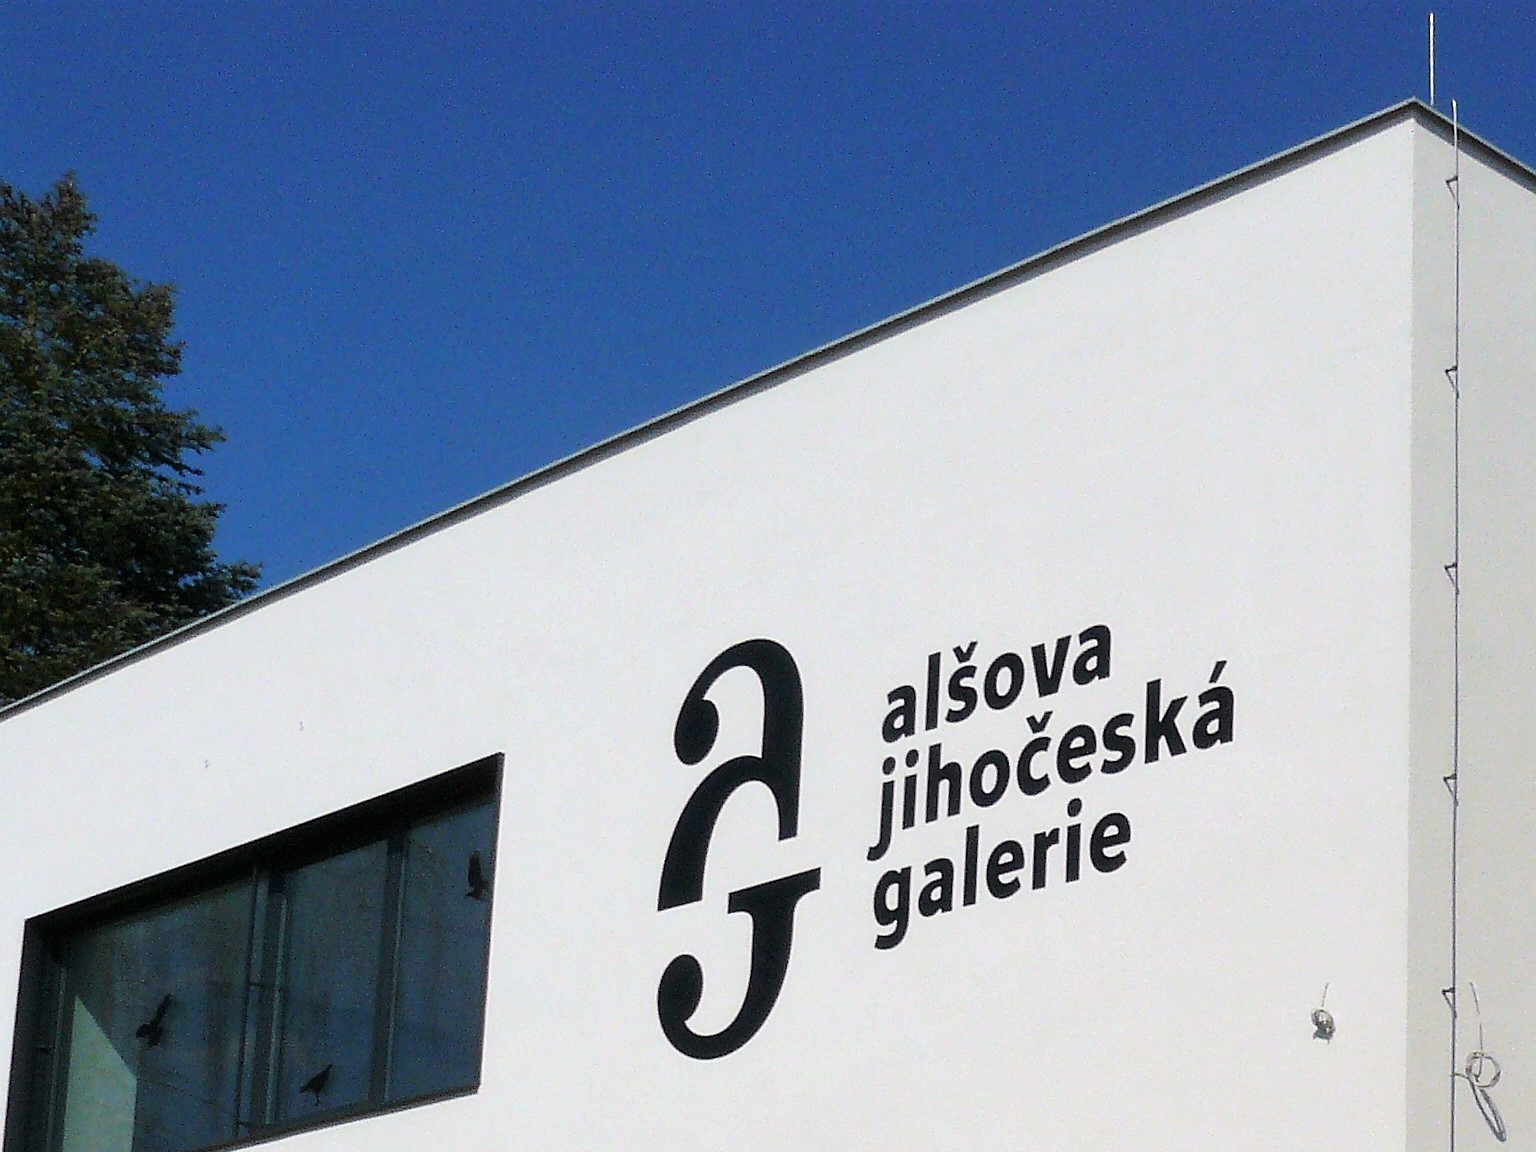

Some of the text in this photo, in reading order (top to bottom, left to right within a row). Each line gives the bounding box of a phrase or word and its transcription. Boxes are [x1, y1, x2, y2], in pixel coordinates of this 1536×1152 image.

[881, 624, 1112, 744] alšova
[866, 660, 1234, 862] jihočeská
[873, 797, 1131, 950] galerie
